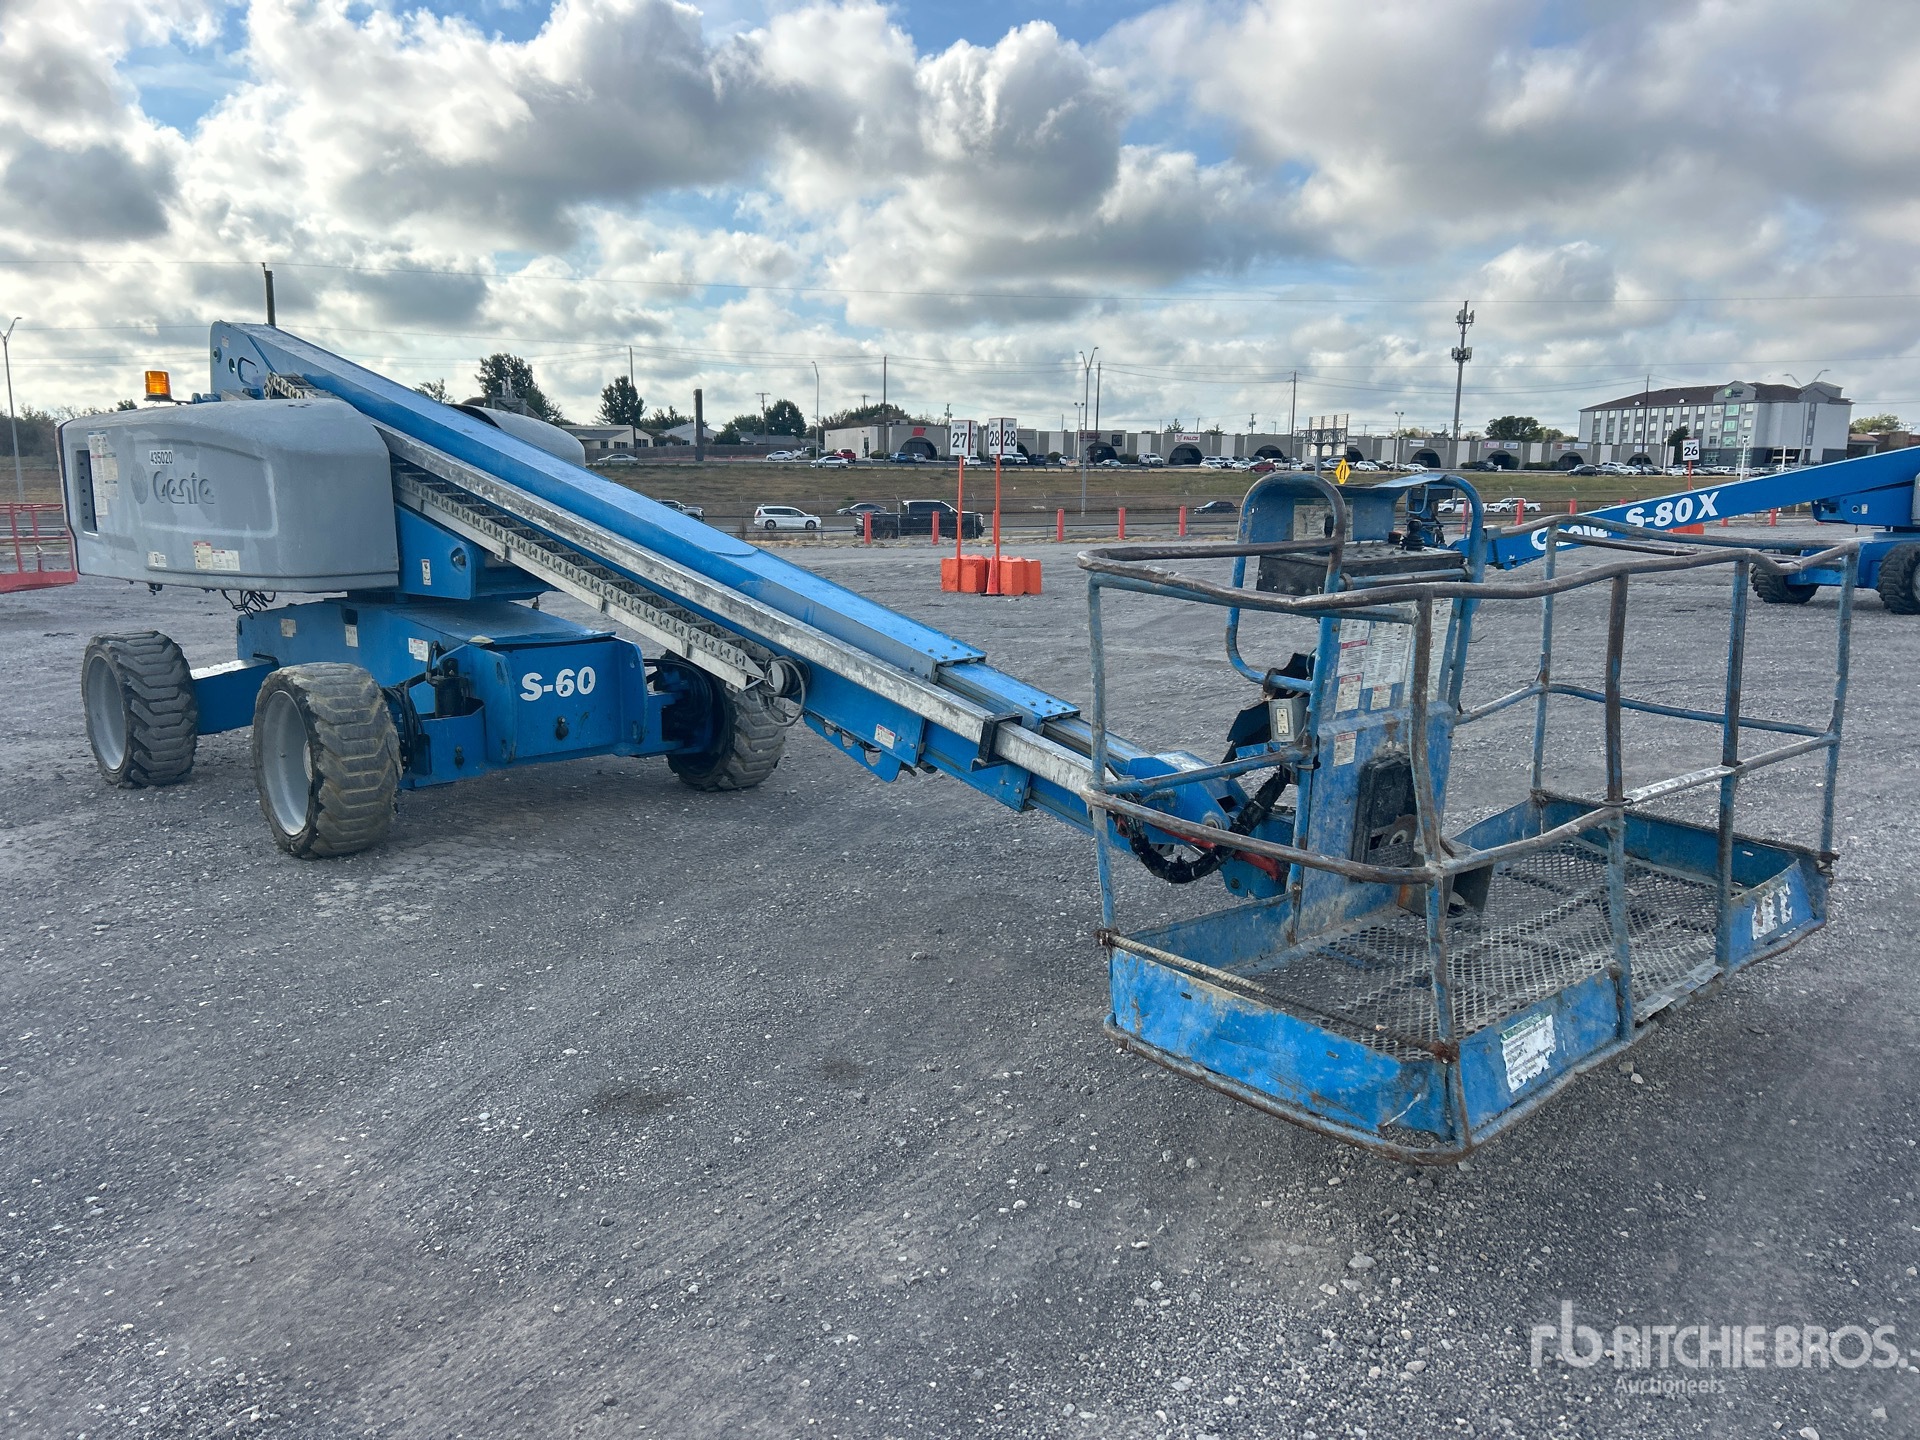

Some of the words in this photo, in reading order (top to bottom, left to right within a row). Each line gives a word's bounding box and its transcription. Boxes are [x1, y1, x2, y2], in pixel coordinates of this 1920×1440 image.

[952, 432, 967, 448] 27
[989, 430, 1000, 447] 28
[1004, 430, 1016, 447] 28
[150, 451, 173, 465] 435020
[1684, 446, 1698, 457] 26
[152, 470, 215, 505] Genie
[519, 666, 596, 702] S-60
